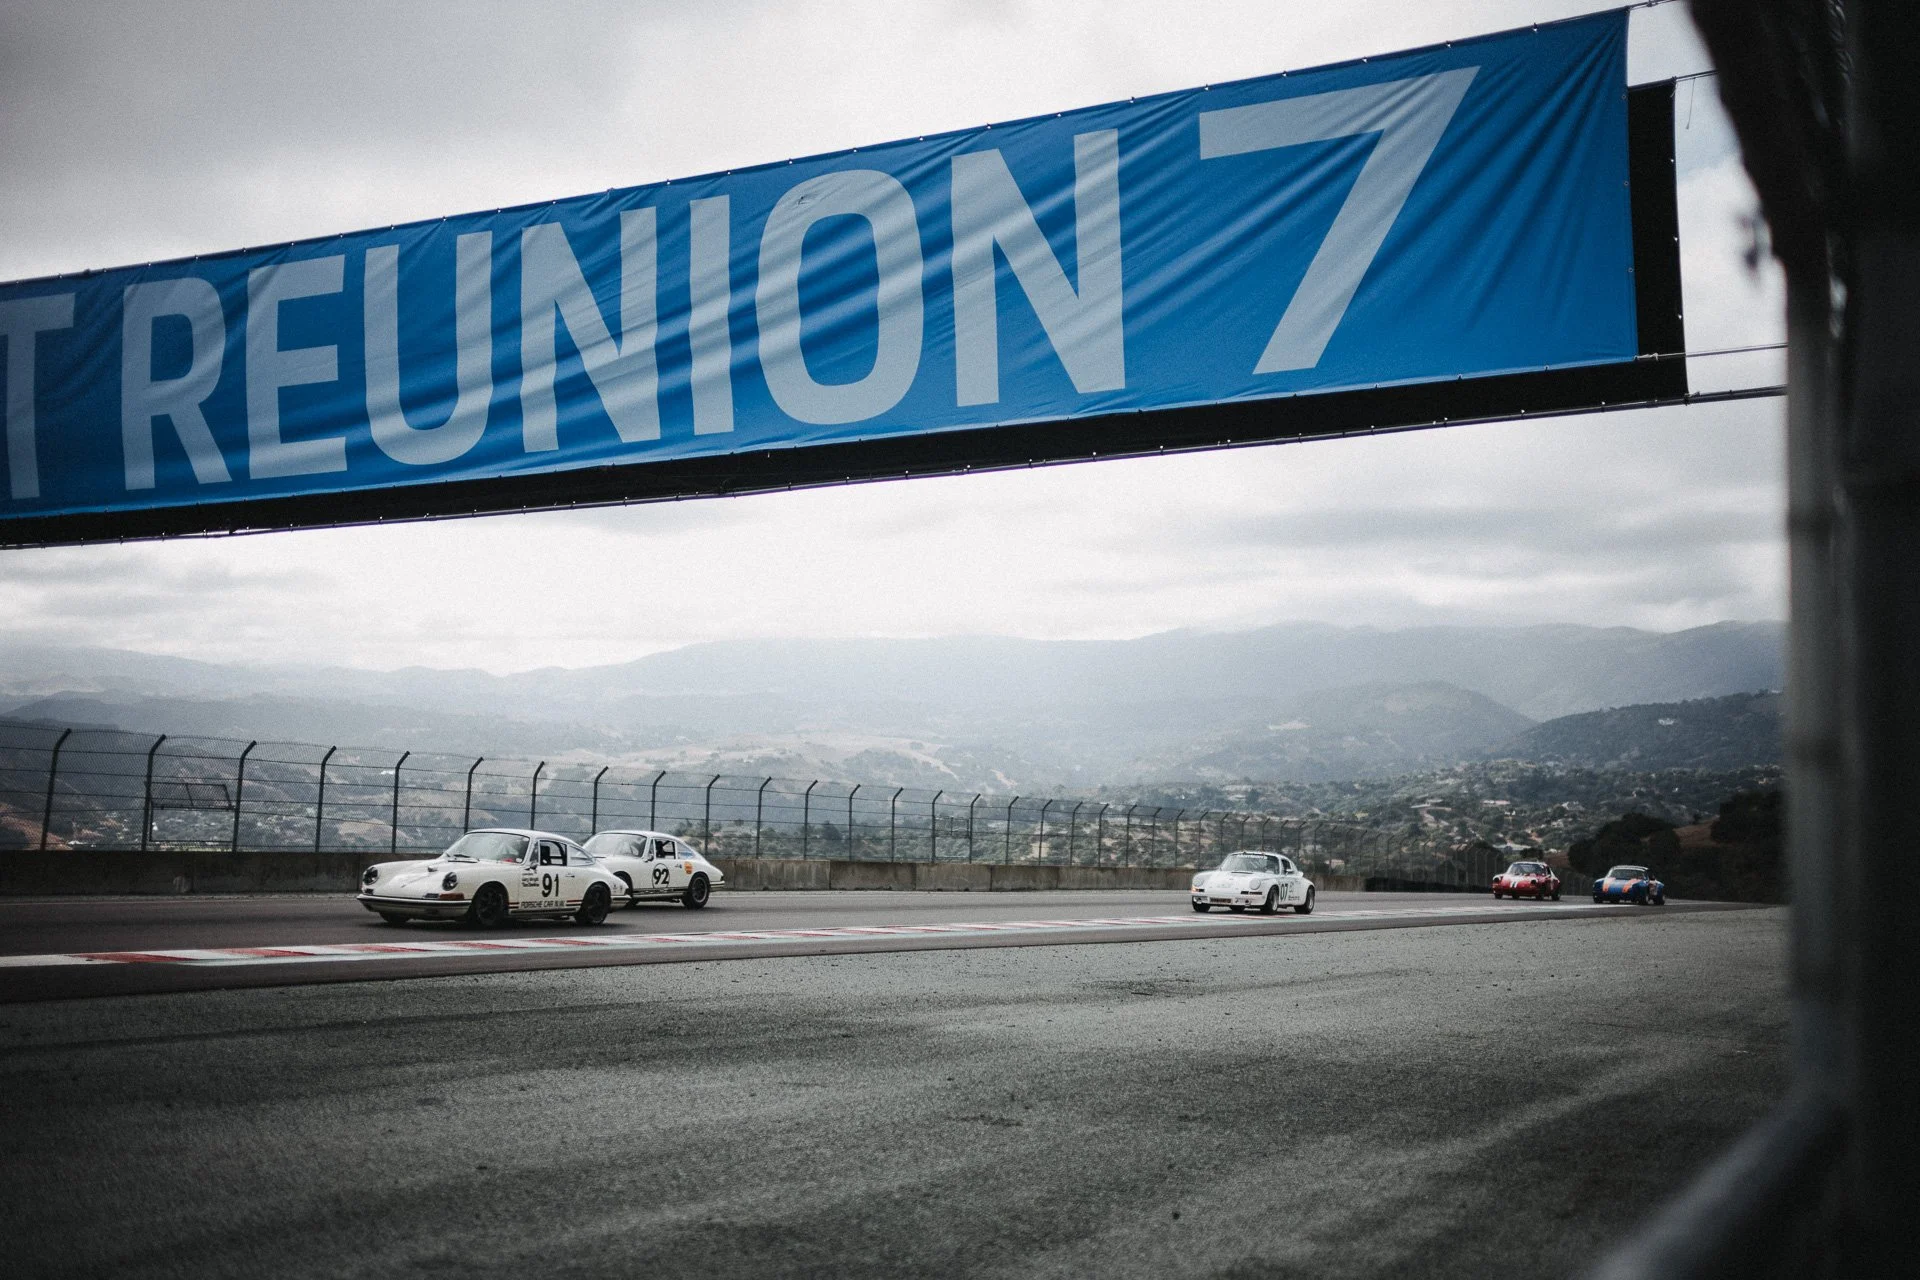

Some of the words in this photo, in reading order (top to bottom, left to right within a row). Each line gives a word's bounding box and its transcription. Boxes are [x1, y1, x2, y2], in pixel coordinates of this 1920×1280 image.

[121, 129, 1125, 490] REUNION
[1200, 66, 1481, 375] 7
[541, 873, 560, 898] 91
[652, 868, 670, 885] 92
[1280, 883, 1289, 901] 07
